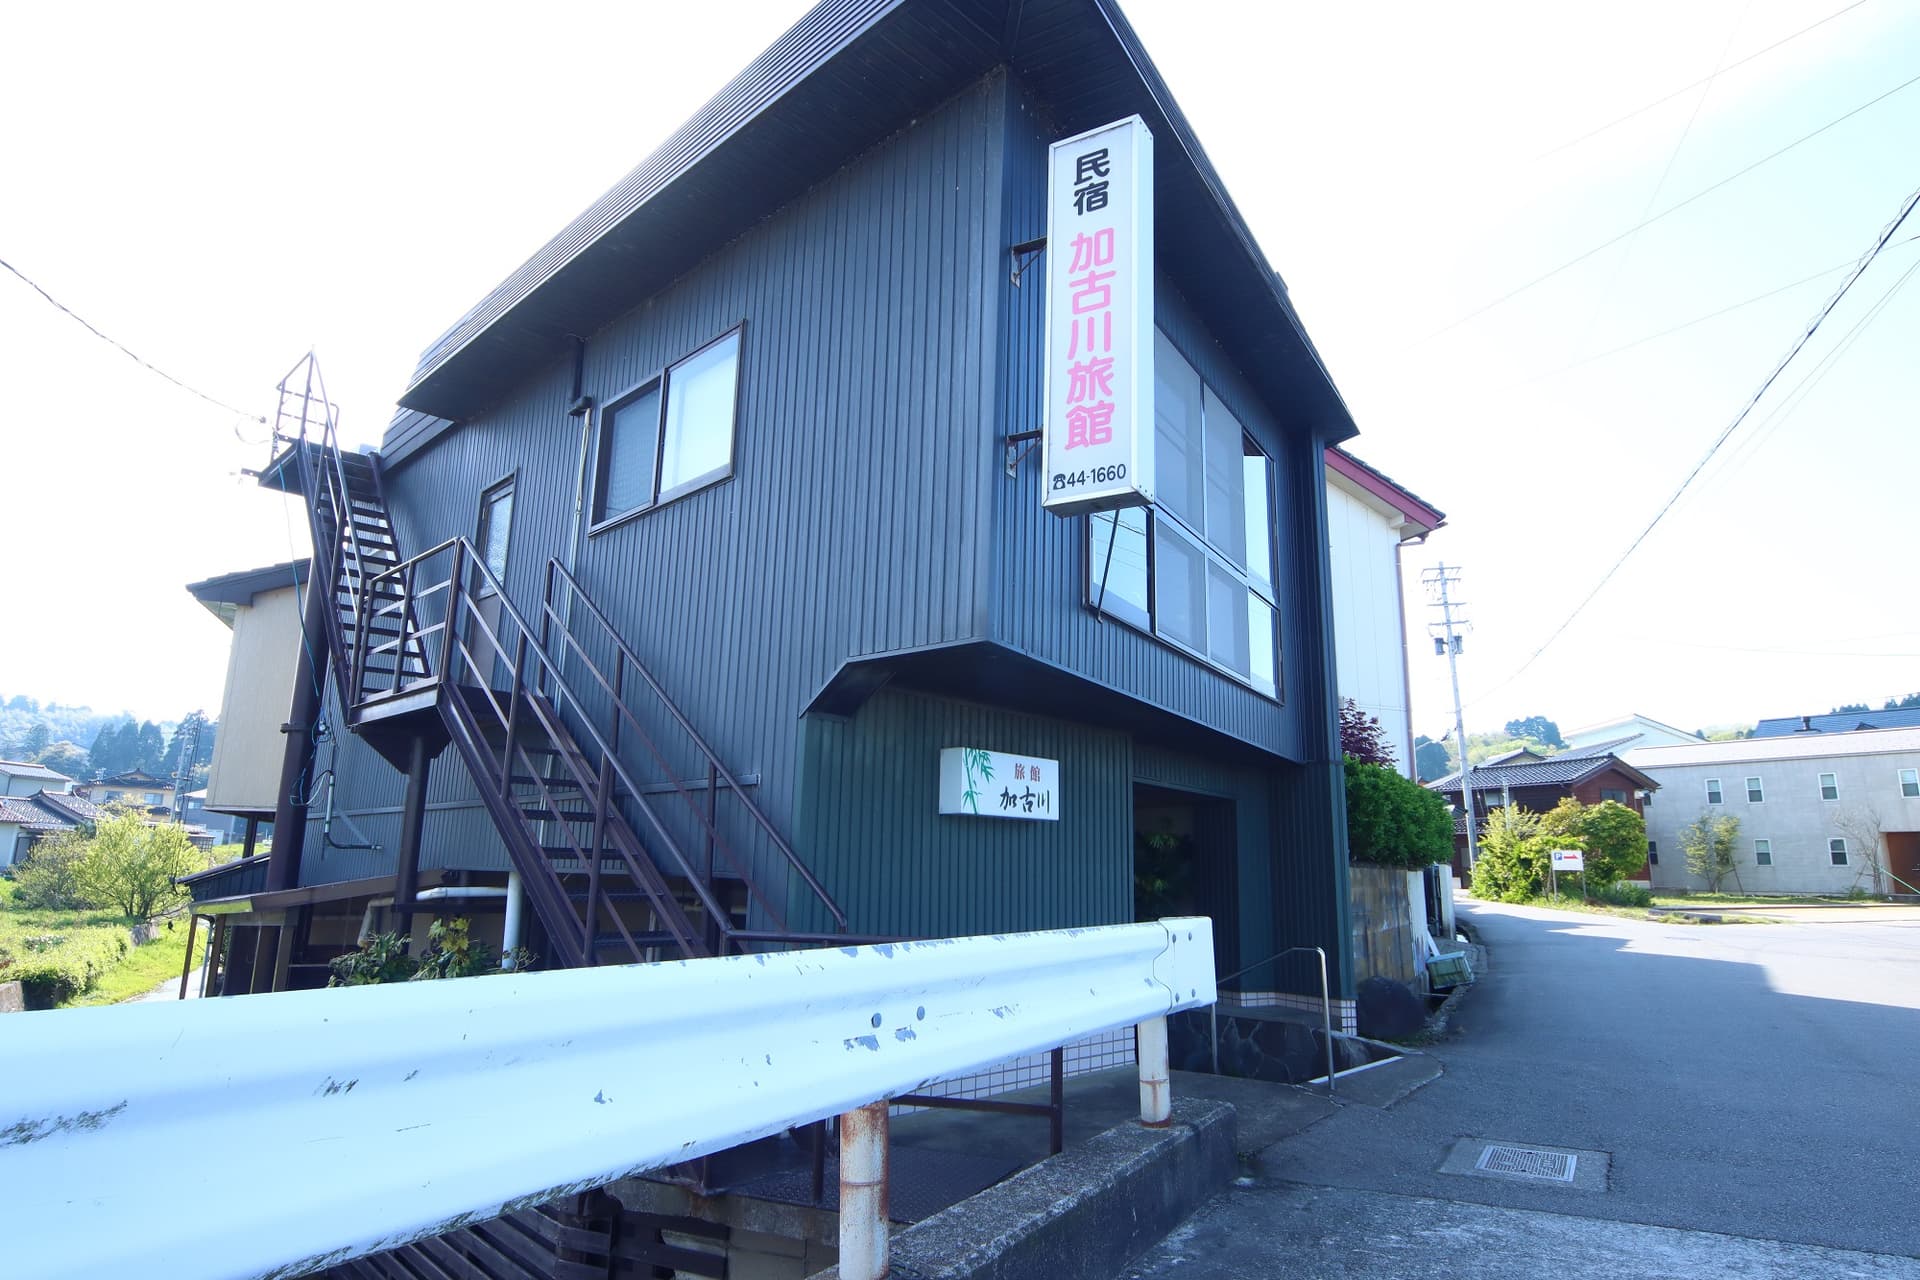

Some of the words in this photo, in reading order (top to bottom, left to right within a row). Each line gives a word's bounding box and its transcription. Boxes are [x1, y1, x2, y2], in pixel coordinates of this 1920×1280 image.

[1073, 148, 1110, 216] 民宿
[1065, 227, 1116, 450] 加古川旅館
[1066, 463, 1127, 487] 44-1660
[1014, 763, 1041, 782] 旅館
[1000, 786, 1050, 814] 加古川
